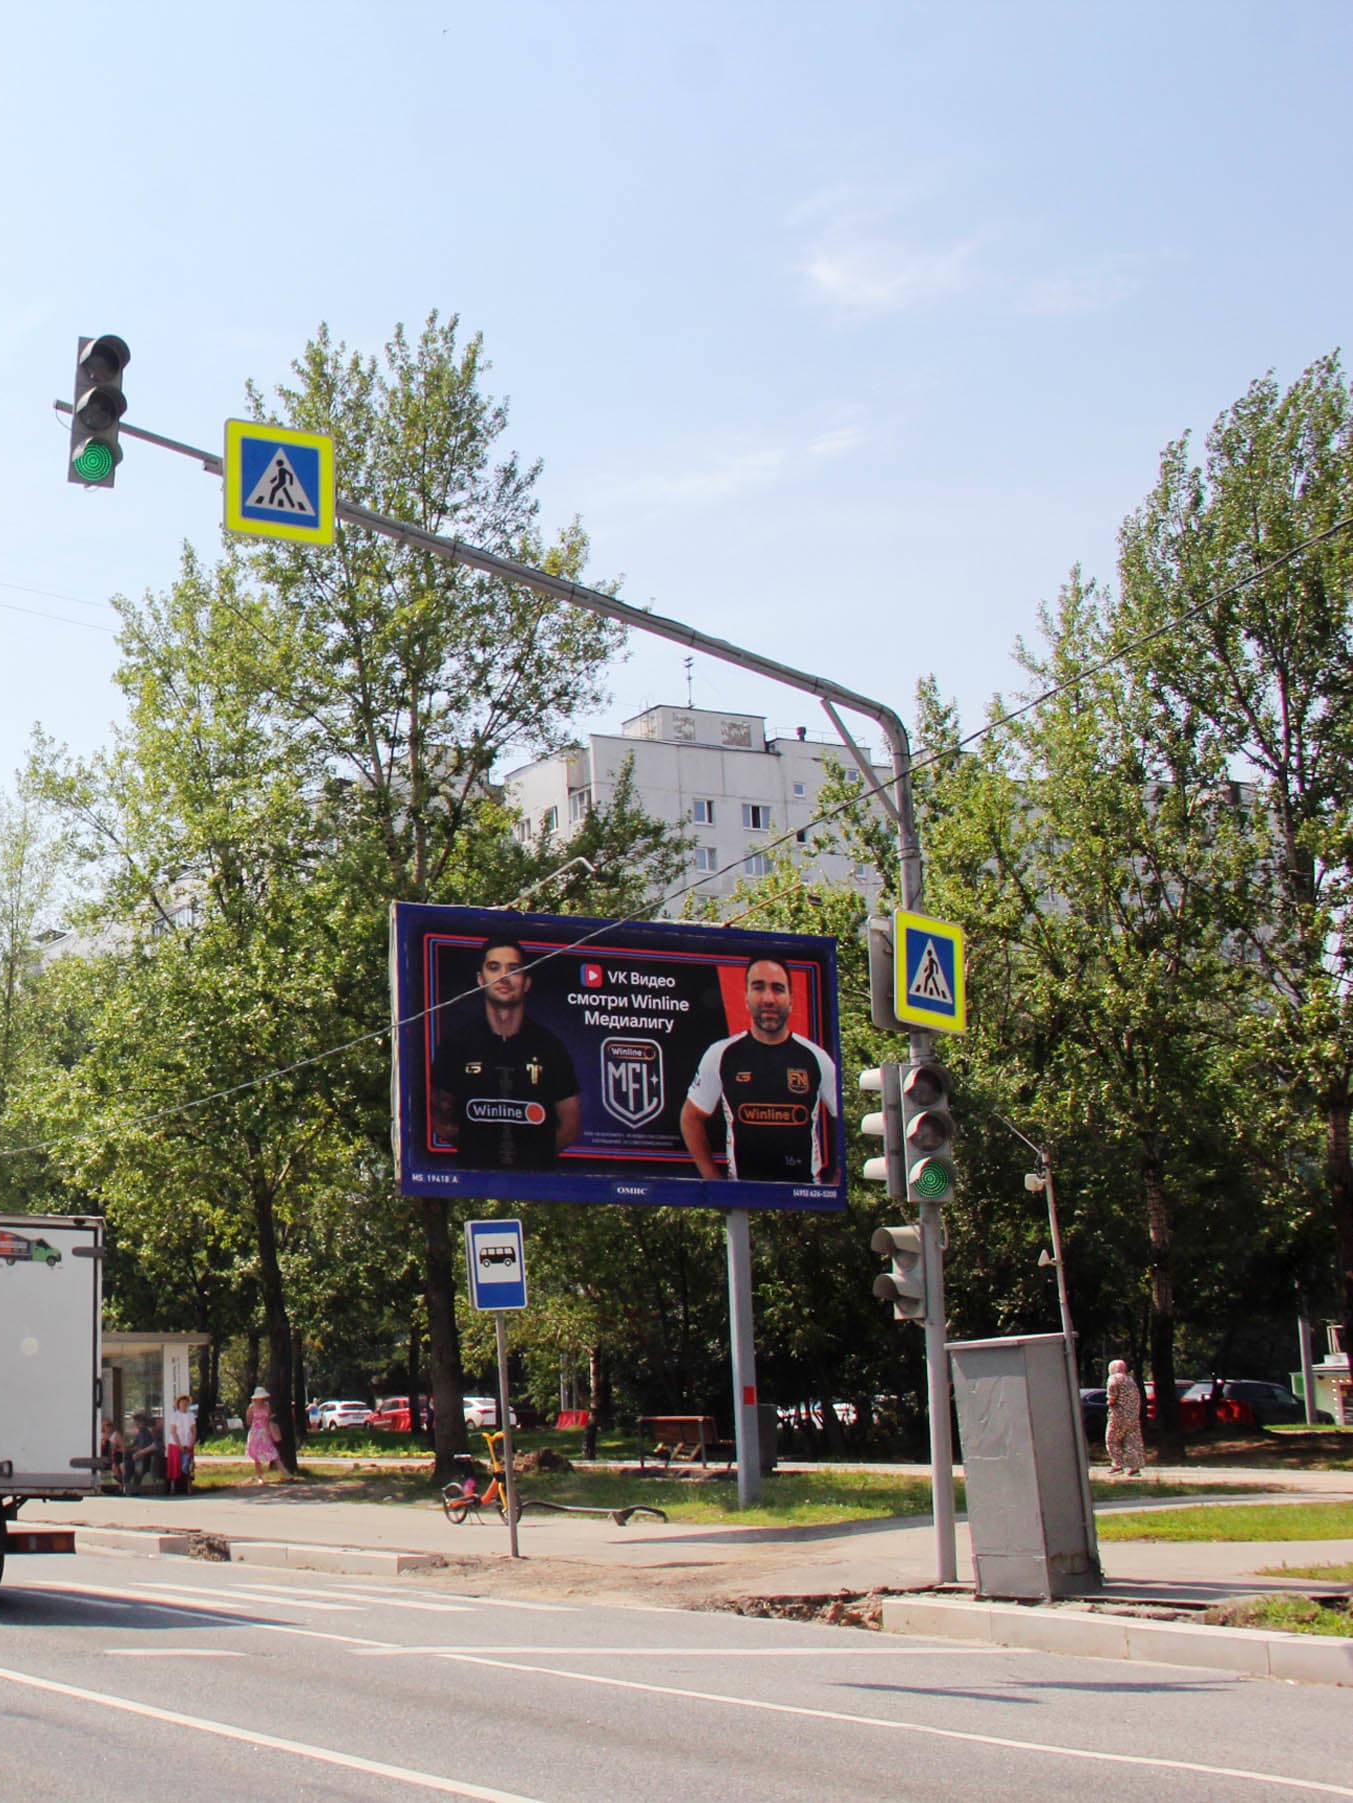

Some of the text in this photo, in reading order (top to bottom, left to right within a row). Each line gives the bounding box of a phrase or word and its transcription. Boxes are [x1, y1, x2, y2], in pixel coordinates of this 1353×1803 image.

[607, 970, 676, 988] VK Видео
[567, 993, 690, 1012] смотри Winline
[584, 1010, 674, 1034] Медиалигу
[472, 1103, 524, 1119] Winline
[744, 1108, 791, 1121] Winline
